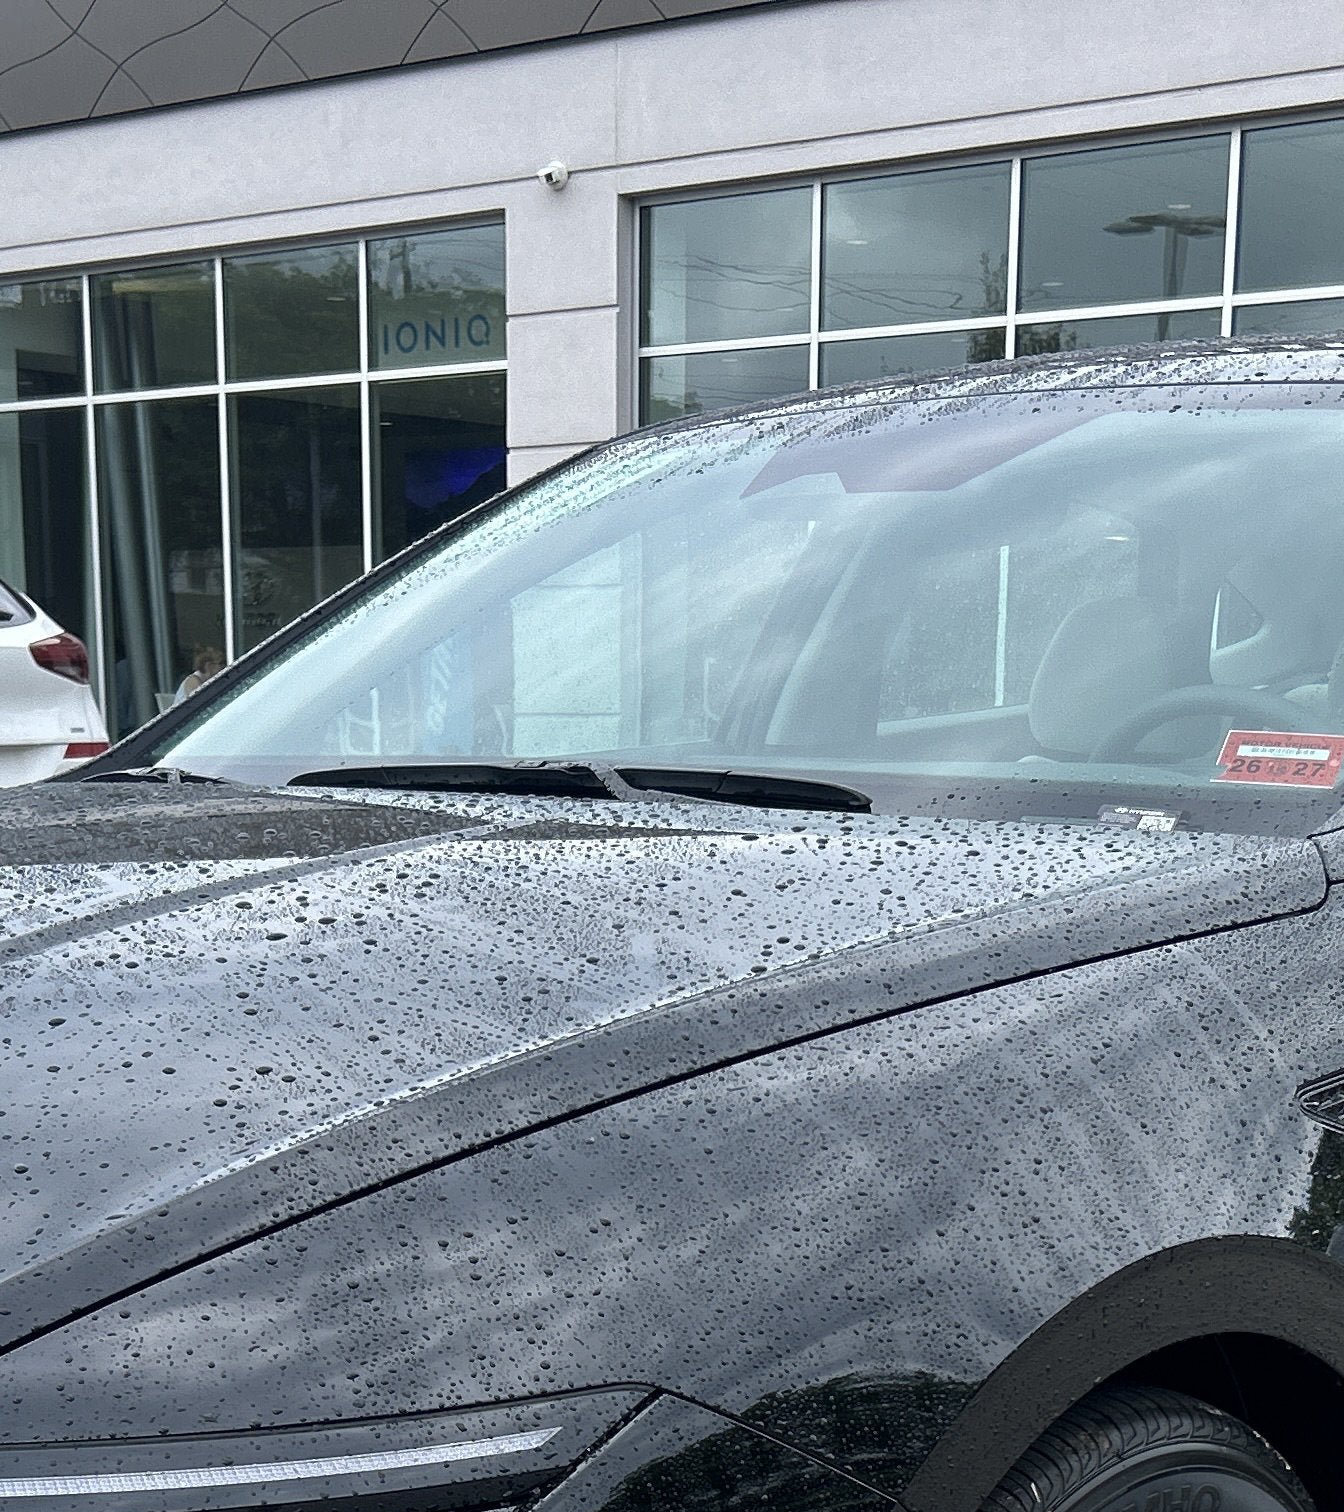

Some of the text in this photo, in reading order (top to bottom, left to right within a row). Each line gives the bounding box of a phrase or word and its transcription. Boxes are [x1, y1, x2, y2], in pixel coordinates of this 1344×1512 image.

[383, 314, 491, 355] IONIQ
[1229, 758, 1263, 774] 26
[1291, 762, 1327, 778] 27
